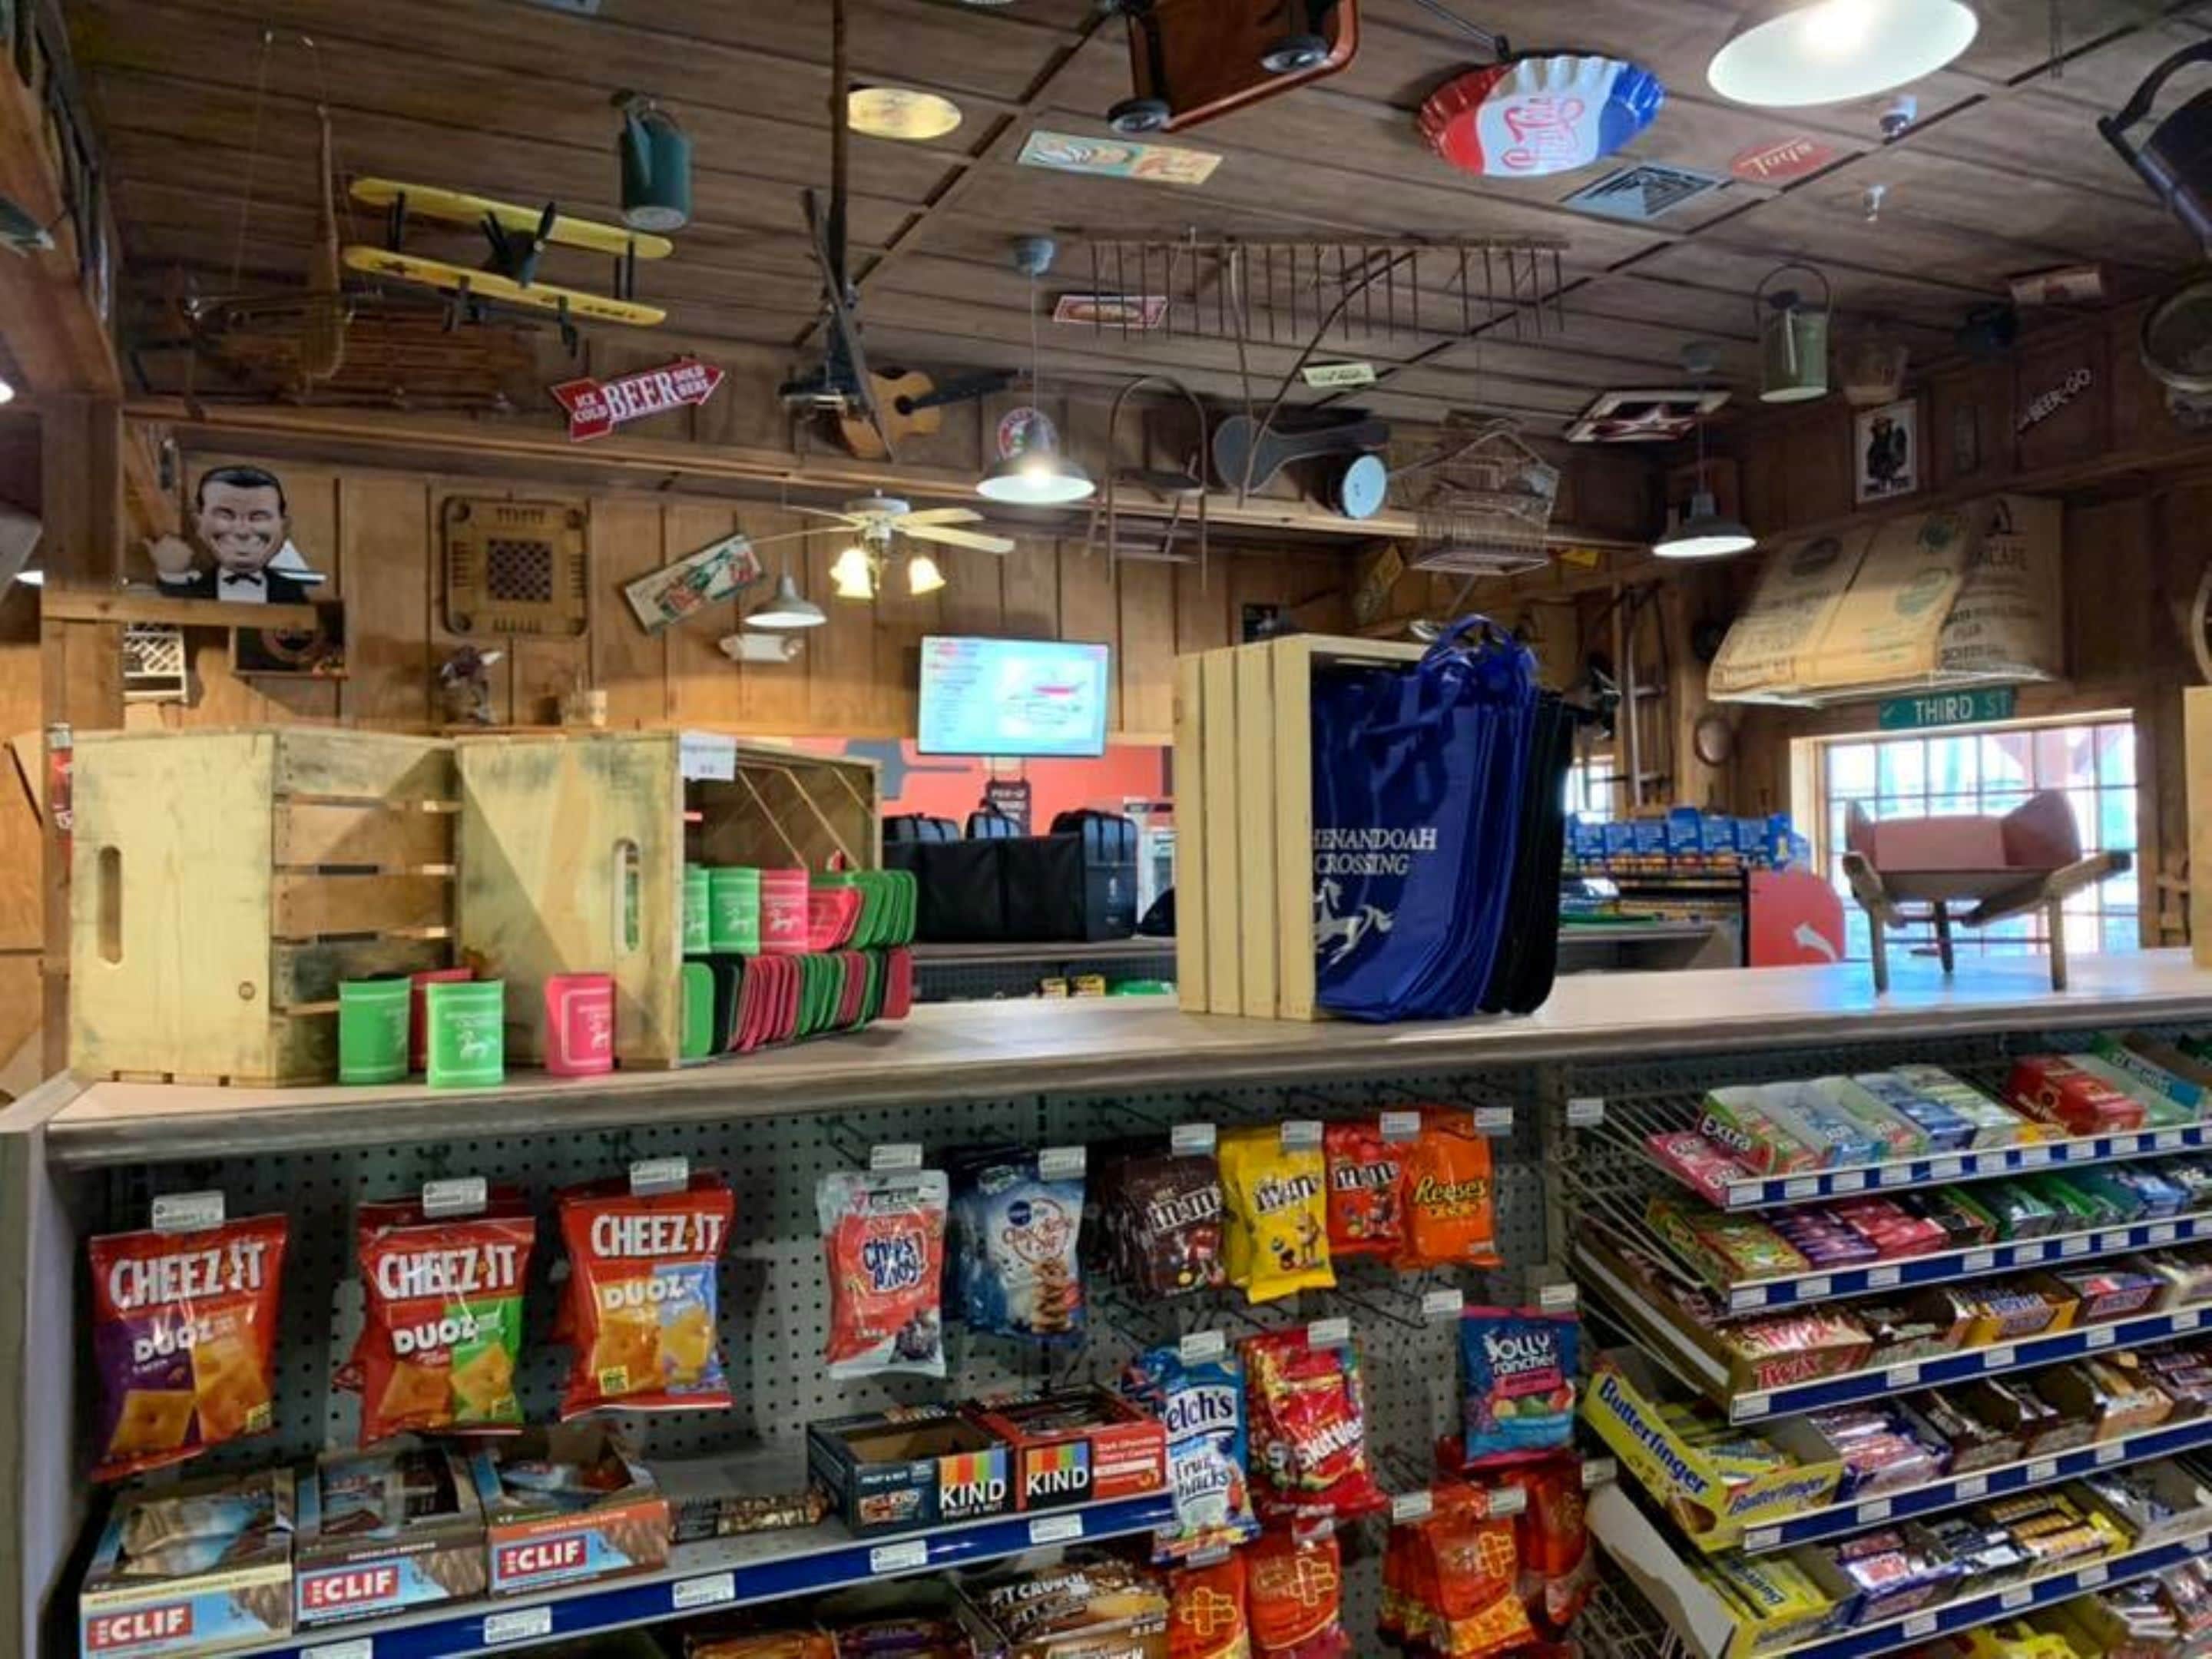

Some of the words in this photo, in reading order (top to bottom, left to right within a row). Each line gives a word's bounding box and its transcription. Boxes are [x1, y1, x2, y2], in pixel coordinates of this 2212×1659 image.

[573, 404, 608, 422] COLD
[604, 372, 674, 421] BEER
[1916, 694, 1973, 724] THIRD
[1984, 690, 2011, 717] ST
[1315, 853, 1409, 876] CROSSING
[1167, 1390, 1233, 1432] elch's
[1598, 1375, 1710, 1495] Butterfinger
[939, 1478, 1006, 1511] KIND
[1025, 1466, 1089, 1496] KIND
[518, 1540, 580, 1571] CLIF
[323, 1569, 392, 1601] CLIF
[111, 1607, 185, 1641] CLIF
